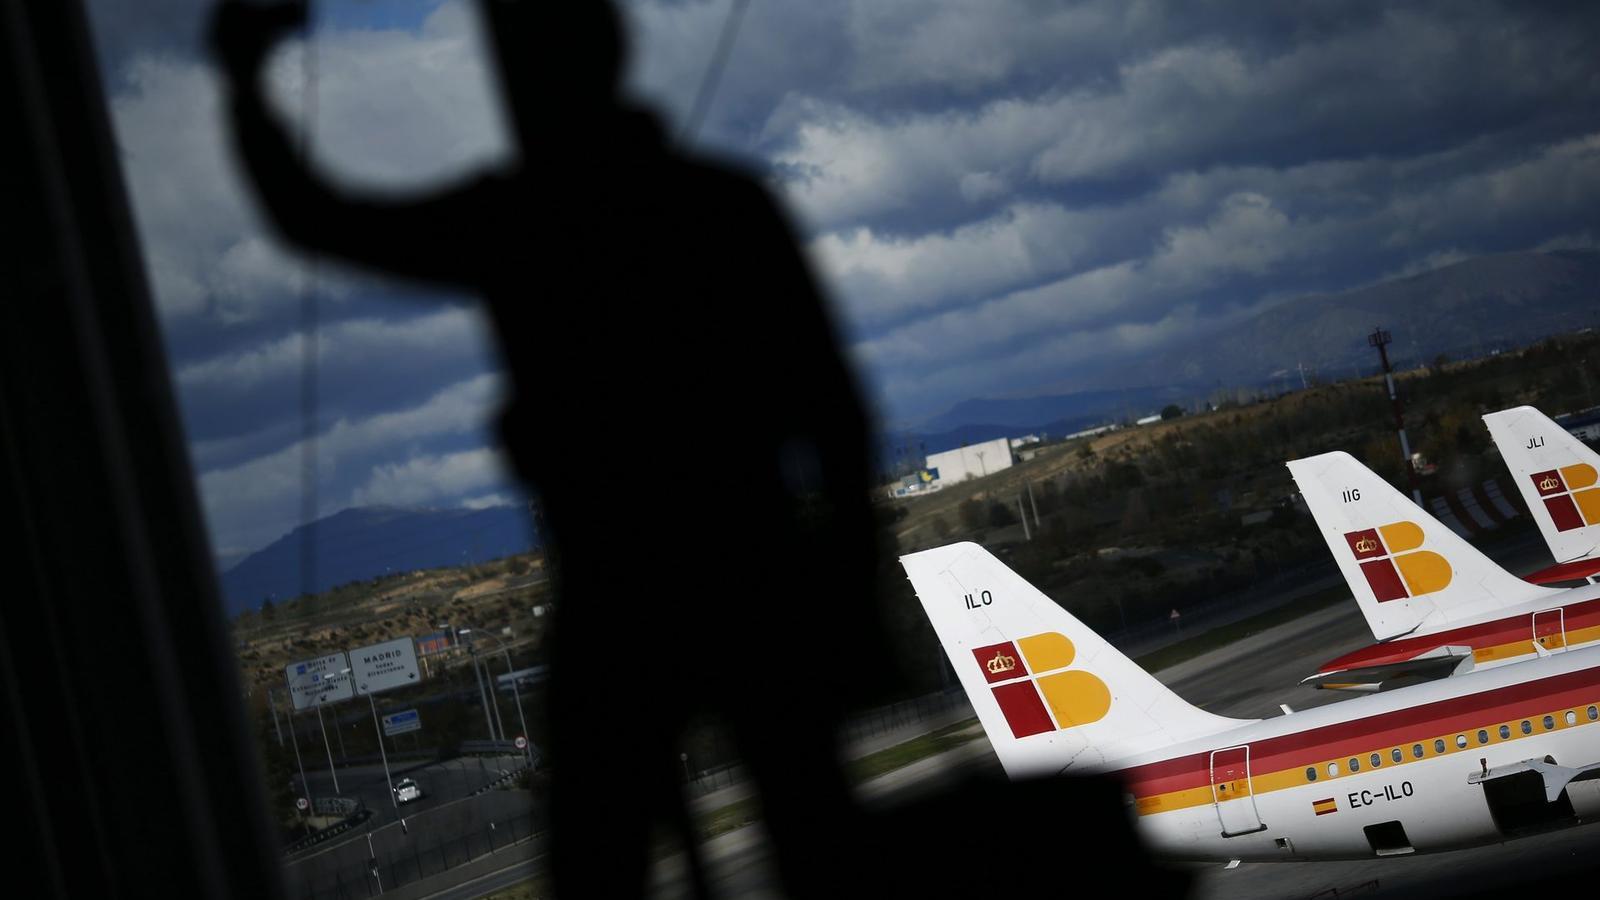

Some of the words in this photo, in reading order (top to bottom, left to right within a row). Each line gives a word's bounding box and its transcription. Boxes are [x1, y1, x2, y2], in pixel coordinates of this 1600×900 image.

[1526, 436, 1545, 449] JLI
[1342, 488, 1361, 503] IIG
[964, 590, 993, 610] ILO
[363, 649, 401, 664] MADRID
[1347, 781, 1414, 809] EC-ILO
